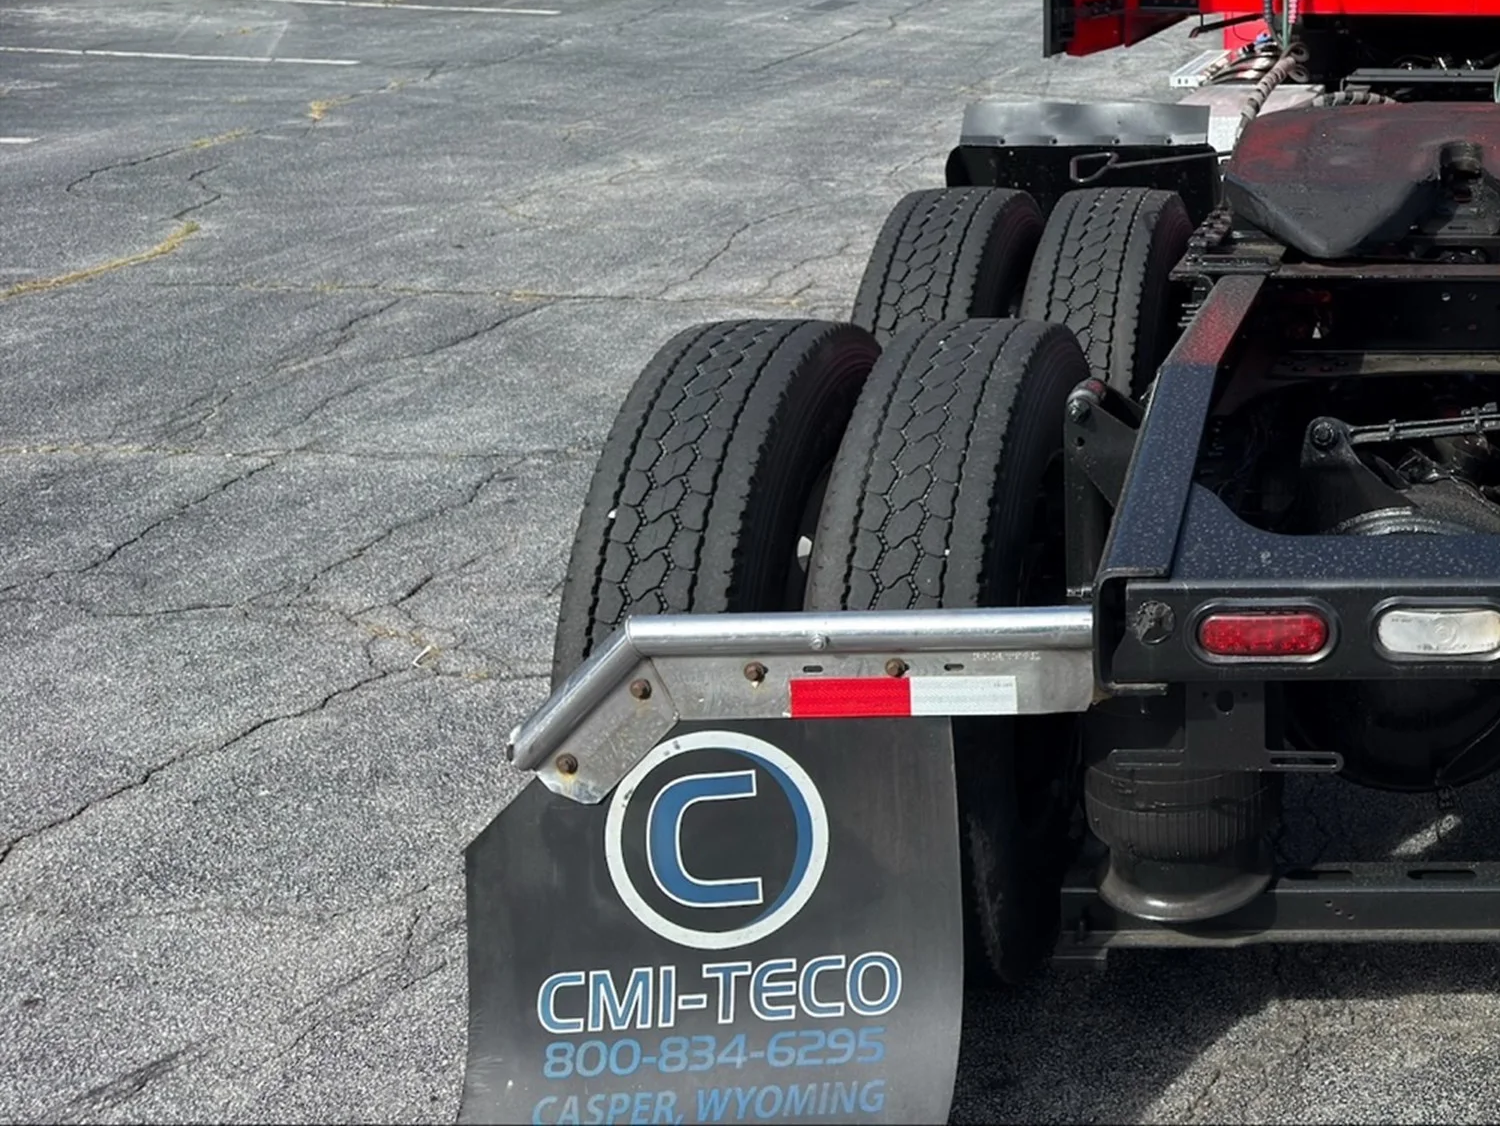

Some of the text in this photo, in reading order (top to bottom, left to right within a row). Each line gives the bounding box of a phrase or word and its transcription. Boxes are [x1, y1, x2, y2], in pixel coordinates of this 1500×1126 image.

[537, 951, 902, 1034] CMI-TECO
[542, 1026, 887, 1079] 800-834-6295
[531, 1079, 886, 1125] CASPER, WYOMING
